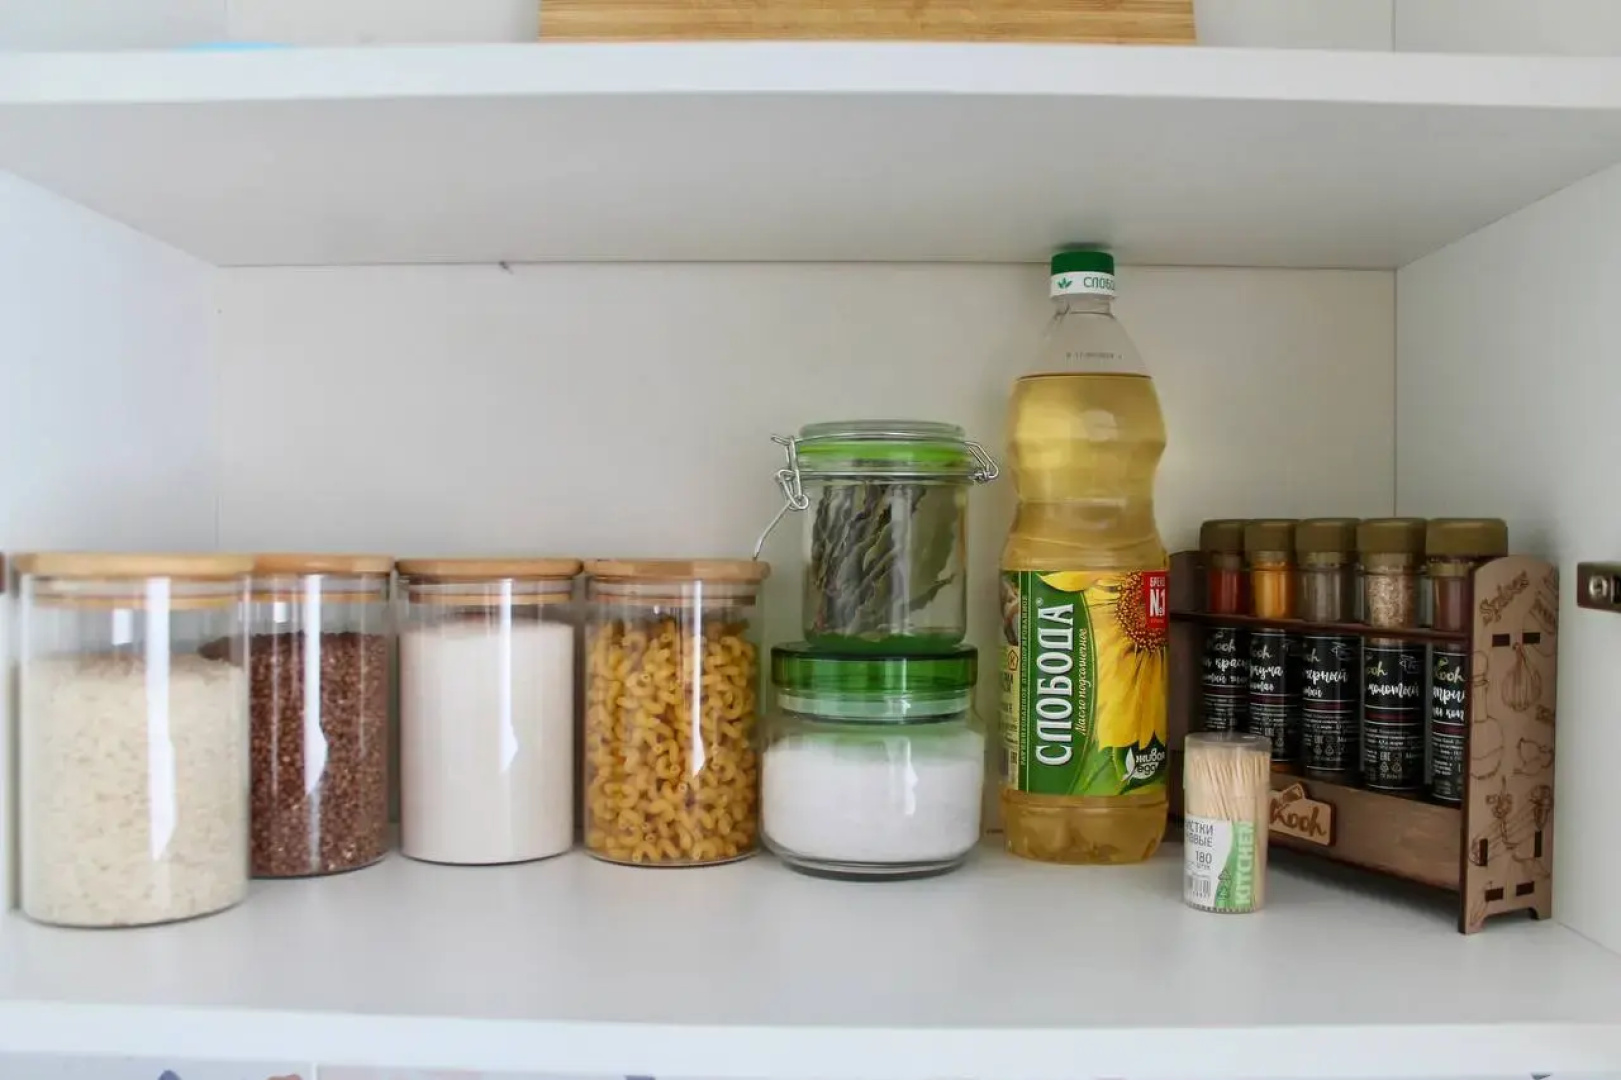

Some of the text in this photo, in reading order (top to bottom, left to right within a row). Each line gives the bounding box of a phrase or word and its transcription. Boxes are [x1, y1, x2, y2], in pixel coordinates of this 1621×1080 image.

[1083, 275, 1116, 291] СЛОБ
[1035, 603, 1074, 767] СЛОБОДА
[1195, 850, 1213, 865] 180
